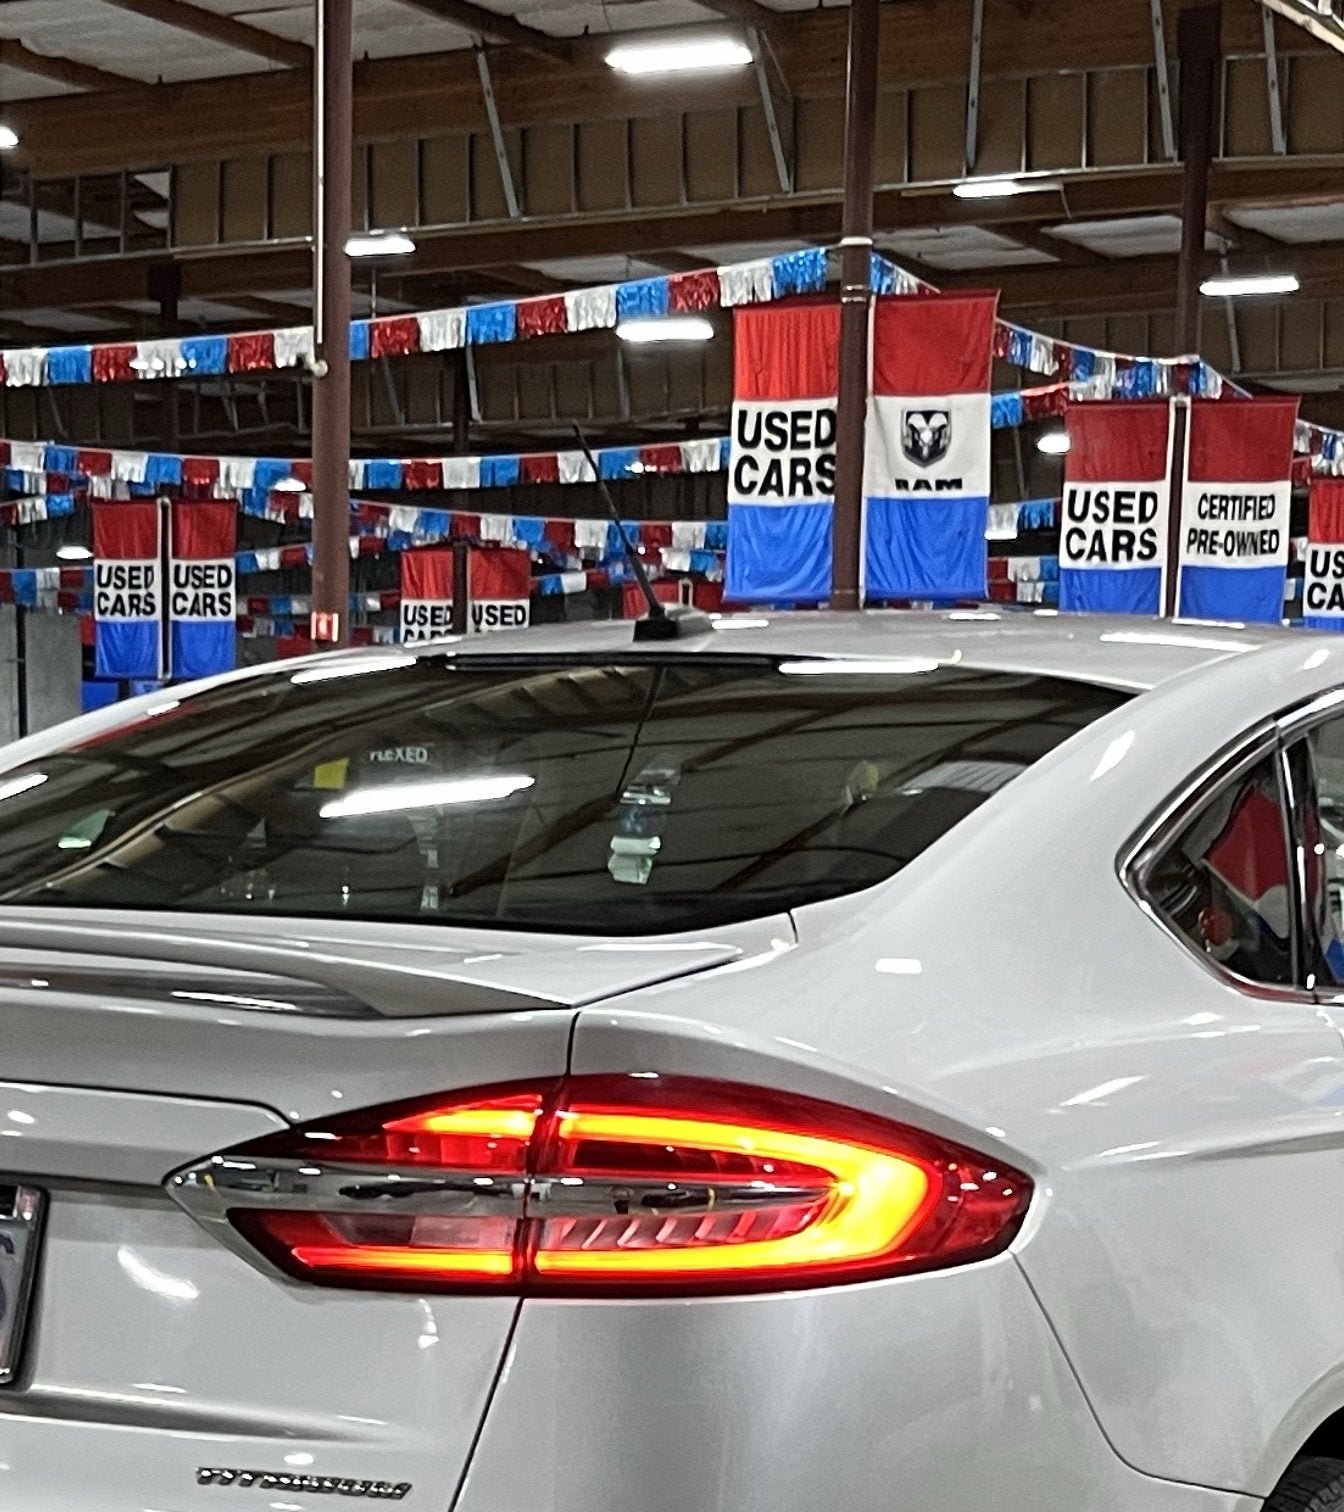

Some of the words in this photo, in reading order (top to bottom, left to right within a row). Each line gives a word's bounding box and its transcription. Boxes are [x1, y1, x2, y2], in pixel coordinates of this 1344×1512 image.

[737, 408, 836, 452] USED
[734, 453, 836, 498] CARS
[895, 477, 963, 492] RAM
[1067, 489, 1158, 524] USED
[1197, 493, 1276, 521] CERTIFIED
[1065, 527, 1158, 562] CARS
[1186, 528, 1280, 557] PRE-OWNED
[97, 564, 155, 590] USED
[173, 564, 232, 589] USED
[97, 592, 156, 616] CARS
[172, 592, 232, 617] CARS
[404, 604, 454, 627] USED
[471, 603, 527, 626] USED
